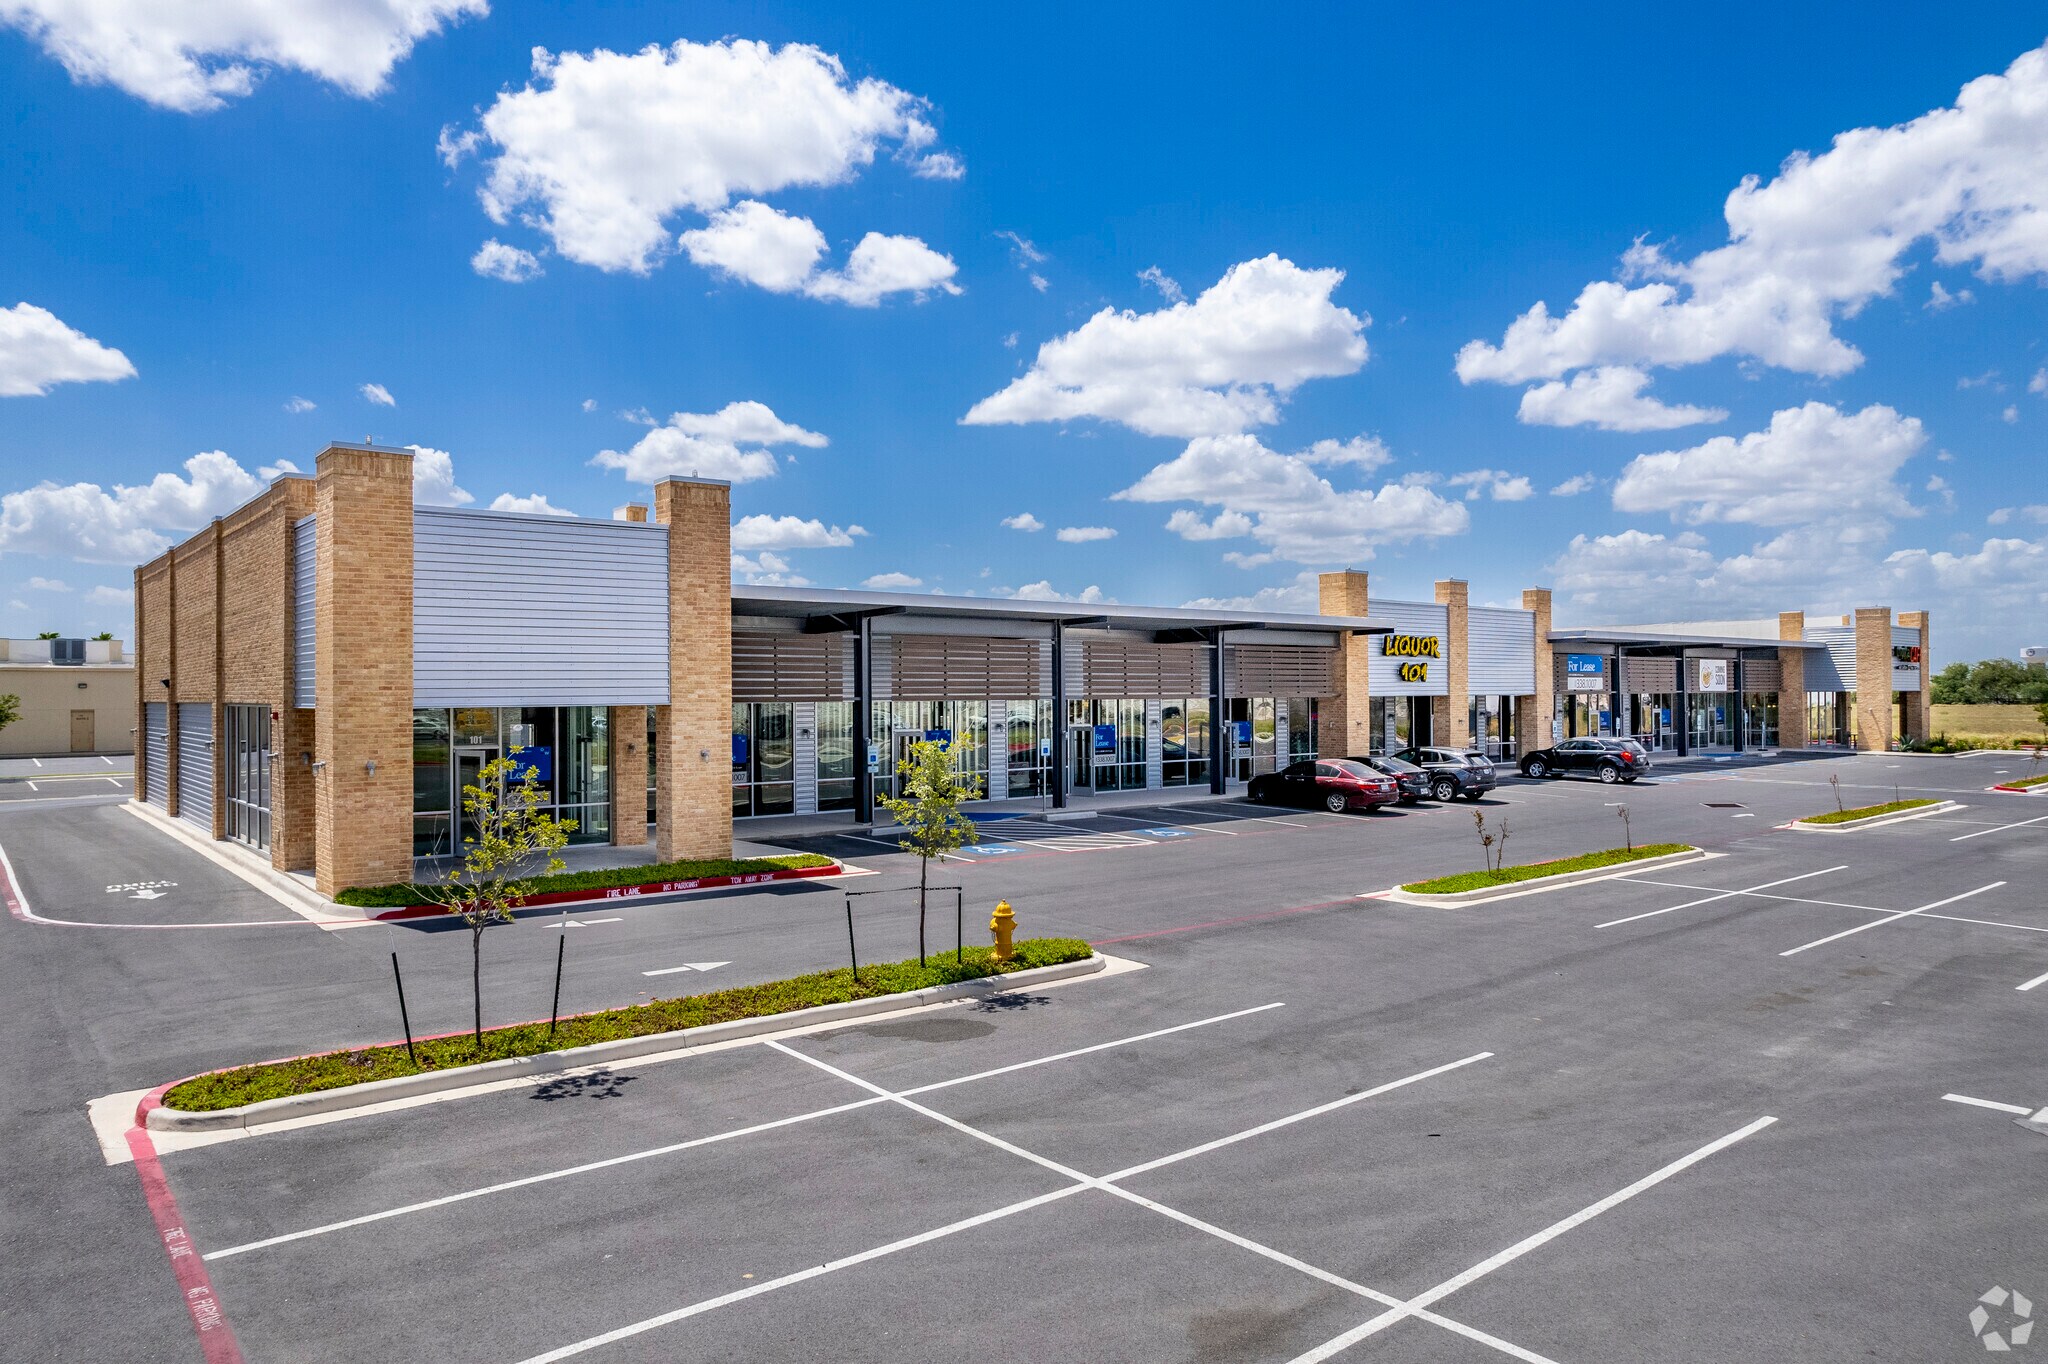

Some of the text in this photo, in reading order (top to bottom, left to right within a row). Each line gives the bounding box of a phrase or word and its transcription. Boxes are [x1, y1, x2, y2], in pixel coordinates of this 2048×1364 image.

[1382, 635, 1440, 658] LIQUOR
[1399, 662, 1428, 682] 101
[1568, 661, 1596, 671] For Lease
[469, 735, 483, 745] 101
[606, 889, 621, 898] FIRE
[623, 887, 641, 896] LANE
[663, 883, 672, 891] NO
[674, 880, 700, 890] PARKING
[744, 875, 757, 883] AWAY
[760, 873, 774, 881] ZONE
[186, 1285, 222, 1331] NO PARKING
